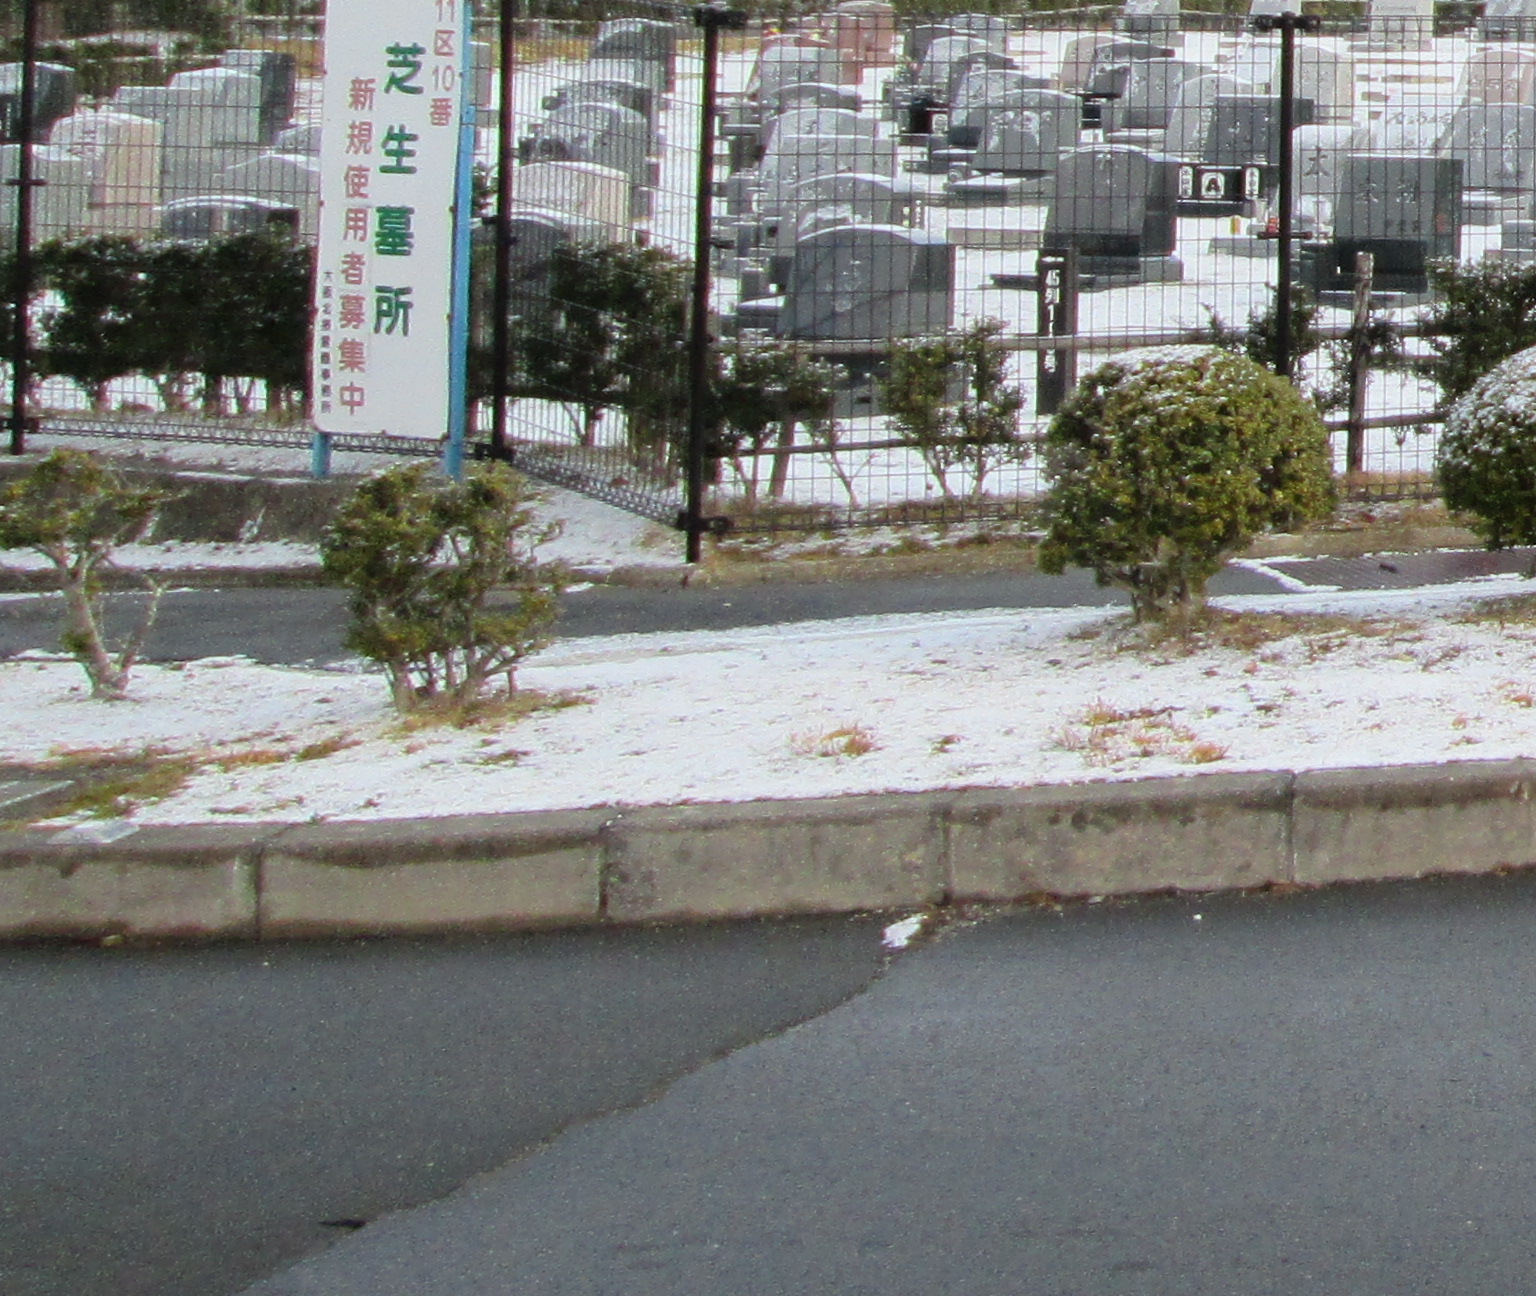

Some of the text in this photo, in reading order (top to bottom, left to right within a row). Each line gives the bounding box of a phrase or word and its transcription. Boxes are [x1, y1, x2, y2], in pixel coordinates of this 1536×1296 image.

[338, 76, 377, 416] 新規使用者募集中
[374, 42, 427, 337] 芝生墓所
